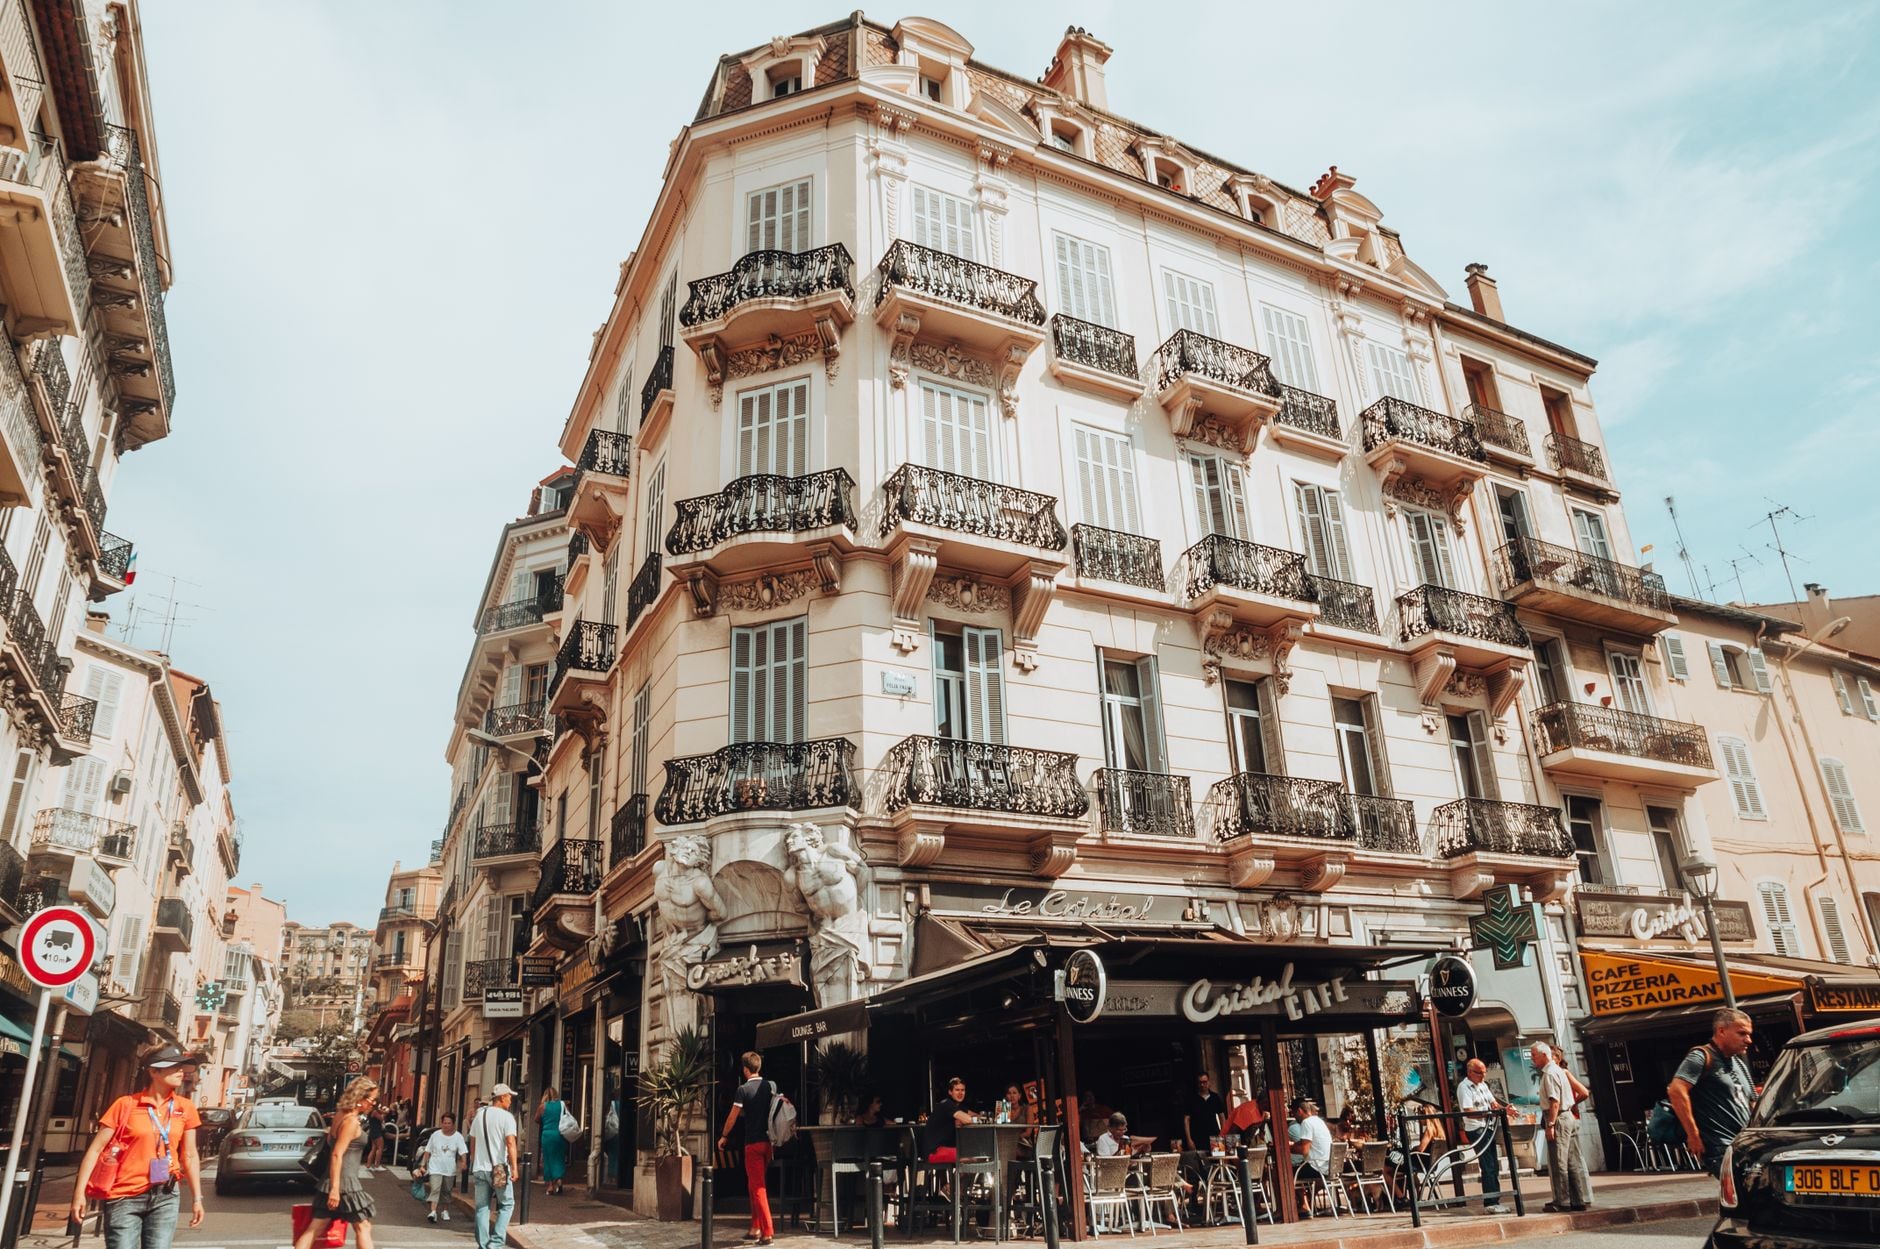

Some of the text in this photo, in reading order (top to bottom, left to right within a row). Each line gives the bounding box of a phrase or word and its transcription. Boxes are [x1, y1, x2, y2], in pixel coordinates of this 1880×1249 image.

[982, 888, 1153, 920] Le Cristal
[1631, 892, 1696, 940] Cristal
[688, 945, 759, 989] Cristal
[1591, 963, 1641, 982] CAFE
[1183, 962, 1296, 1023] Cristal
[1284, 977, 1349, 1021] CAFE
[1593, 973, 1680, 997] PIZZERIA
[815, 1021, 827, 1033] BAR
[1612, 1063, 1630, 1072] WIFI
[1795, 1168, 1823, 1190] 306
[1830, 1168, 1860, 1191] BLF
